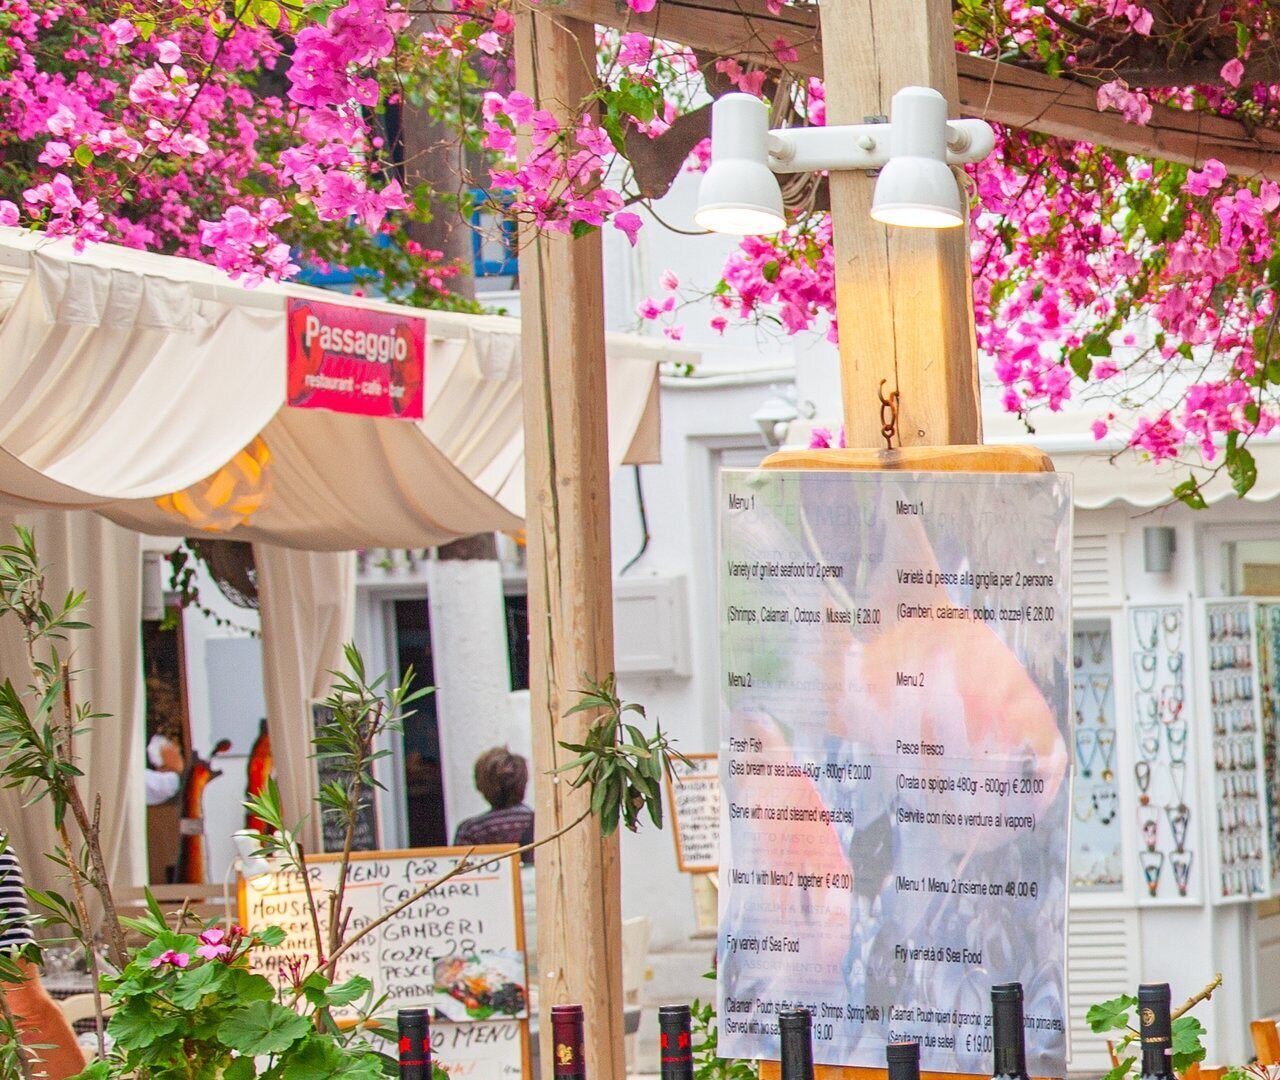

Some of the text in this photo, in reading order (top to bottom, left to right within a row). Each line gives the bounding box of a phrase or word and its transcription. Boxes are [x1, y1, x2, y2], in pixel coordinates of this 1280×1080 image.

[305, 315, 407, 363] Passaggio
[305, 374, 354, 392] restaurant
[389, 382, 405, 397] bar
[729, 494, 755, 509] Menu 1
[896, 501, 924, 515] Menu 1
[728, 561, 843, 581] Variety of grilled seafood for 2 person
[897, 569, 1053, 589] Varietà di pesce alla griglia per 2 persone
[999, 607, 1024, 623] cozze)
[728, 672, 752, 687] Menu 2
[896, 672, 925, 687] Menu 2
[730, 737, 763, 753] Fresh Fish
[896, 740, 944, 756] Pesce fresco
[746, 761, 765, 776] bream
[767, 765, 773, 776] or
[774, 765, 785, 776] sea
[786, 763, 801, 778] bass
[896, 774, 919, 792] (Orata
[921, 779, 926, 789] o
[928, 776, 955, 793] spigola
[751, 805, 763, 820] with
[765, 805, 775, 820] rice
[777, 806, 788, 821] and
[789, 806, 817, 822] steamed
[896, 808, 1036, 830] (Servite con riso e verdure al vapore)
[751, 869, 755, 884] 1
[756, 870, 769, 885] with
[770, 870, 788, 886] Menu
[789, 872, 794, 886] 2
[797, 872, 823, 890] together
[921, 877, 925, 891] 1
[928, 878, 949, 893] Menu
[951, 879, 956, 894] 2
[958, 880, 987, 895] insieme
[989, 883, 1003, 895] con
[383, 920, 483, 941] GAMBERI
[739, 936, 760, 954] variety
[762, 937, 768, 951] of
[769, 936, 782, 952] Sea
[783, 937, 800, 953] Food
[895, 945, 908, 963] Fry
[937, 947, 944, 961] di
[945, 948, 961, 962] Sea
[963, 949, 982, 964] Food
[952, 1009, 958, 1024] di
[453, 1024, 519, 1048] MENU
[924, 1033, 936, 1047] due
